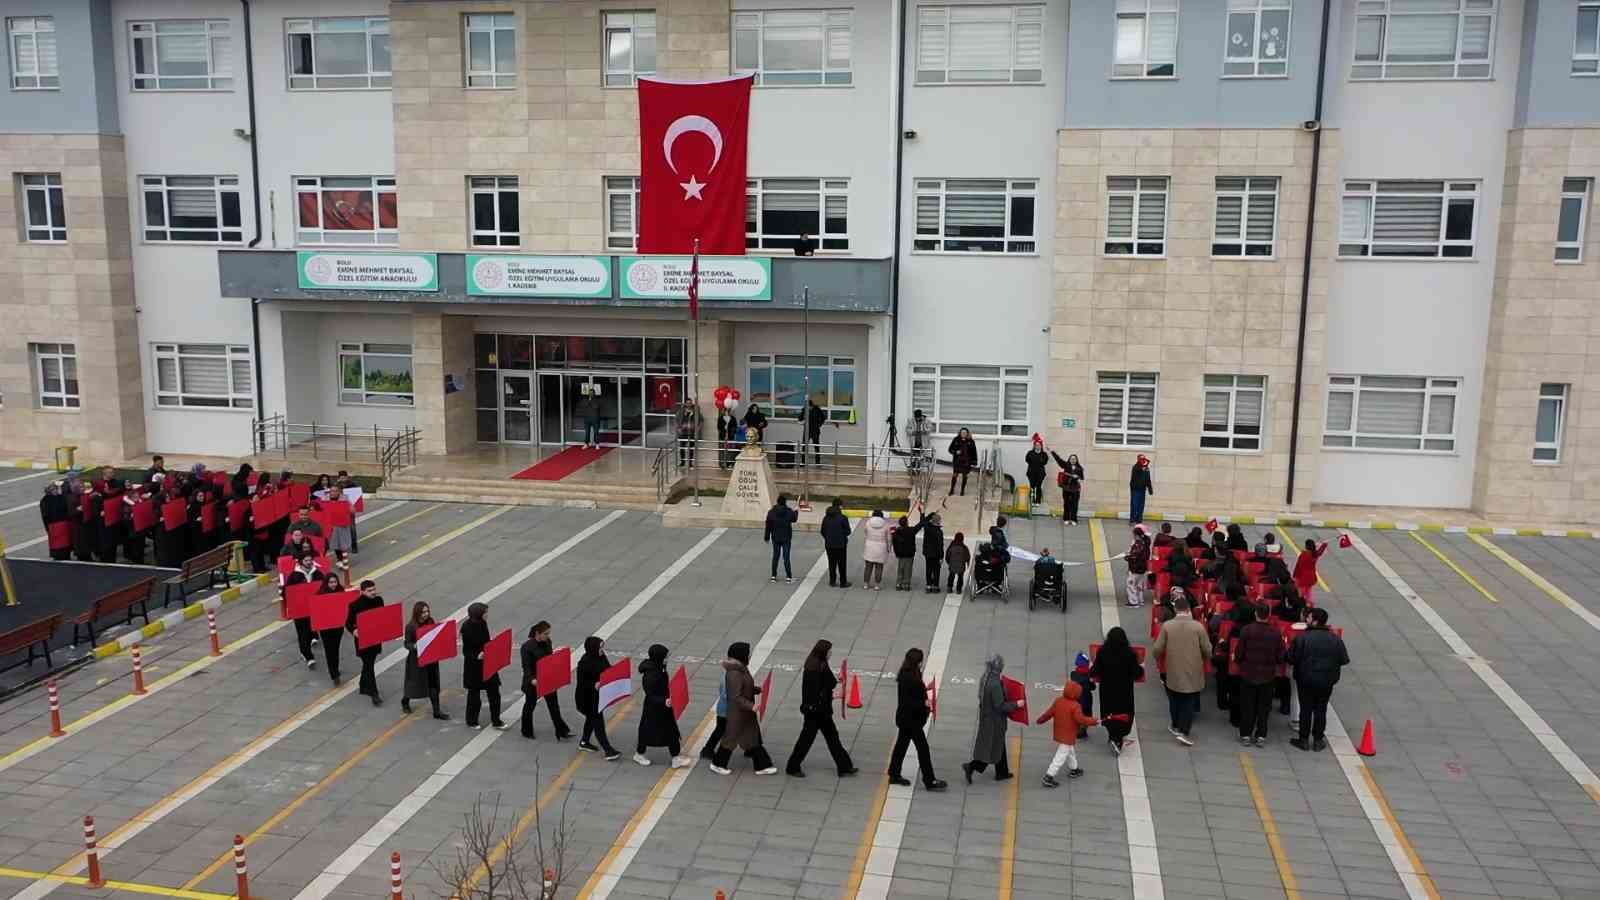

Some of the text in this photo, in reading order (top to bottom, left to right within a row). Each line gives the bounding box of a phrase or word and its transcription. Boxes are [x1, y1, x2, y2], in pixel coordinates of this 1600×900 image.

[389, 267, 414, 275] BAYSAL
[380, 275, 418, 283] ANAOKULU
[702, 278, 737, 286] UYGULAMA
